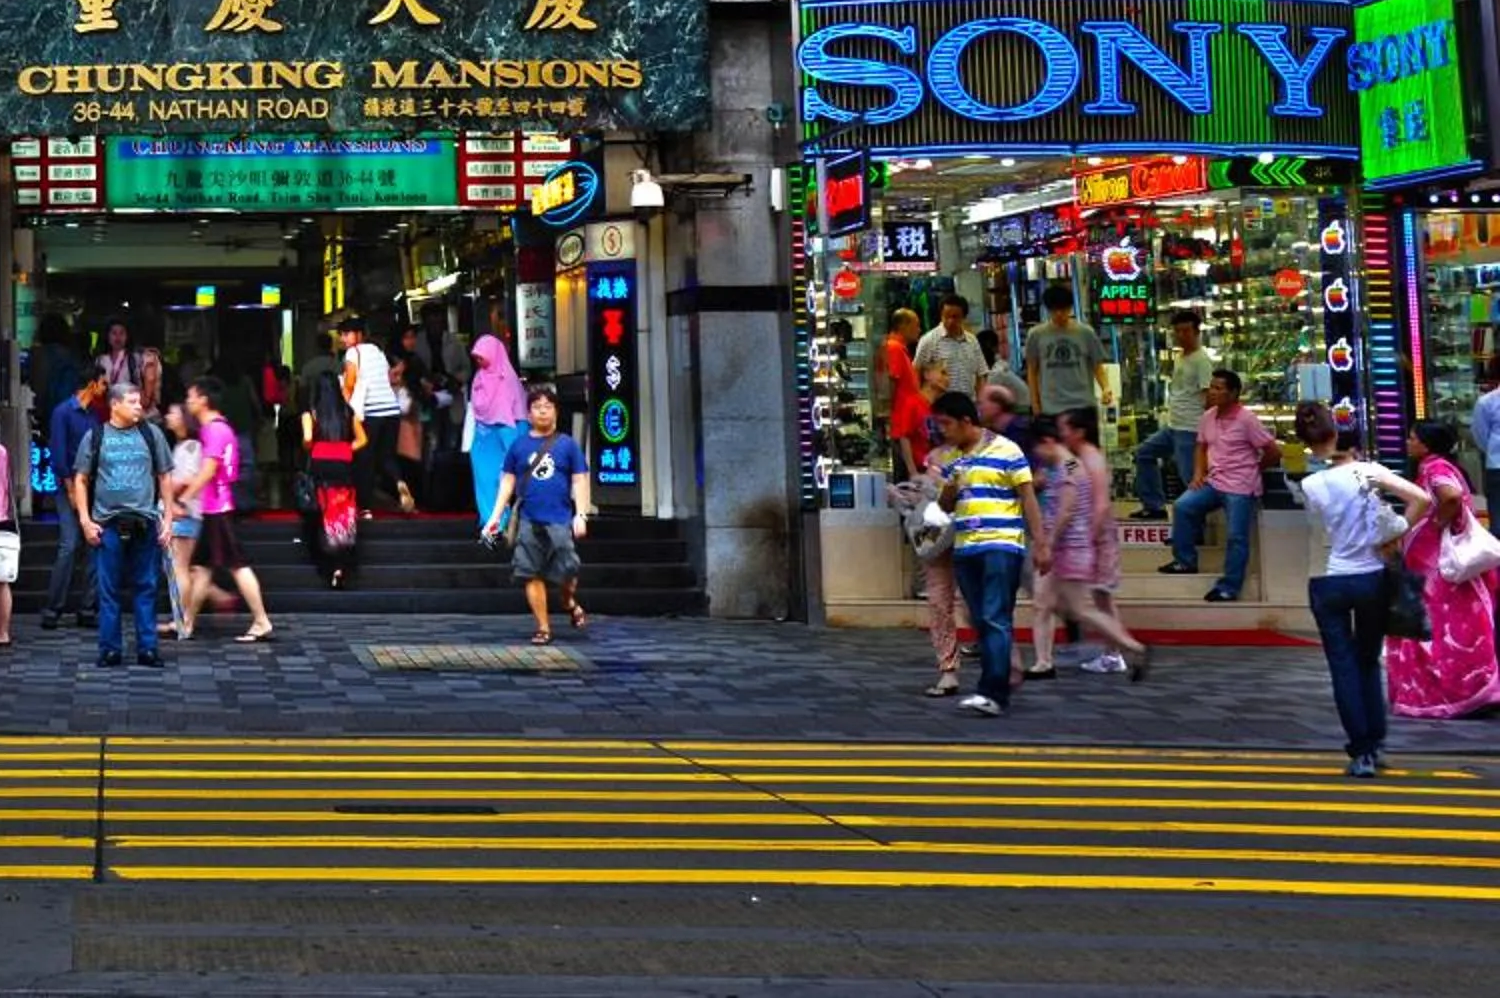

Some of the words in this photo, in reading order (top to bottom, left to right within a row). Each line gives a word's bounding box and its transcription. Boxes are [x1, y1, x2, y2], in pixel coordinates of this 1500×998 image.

[799, 17, 1348, 125] SONY
[1347, 18, 1454, 92] SONY
[17, 61, 343, 95] CHUNGKING
[371, 60, 643, 89] MANSIONS
[73, 102, 140, 123] 36-44,
[149, 100, 248, 120] NATHAN
[258, 98, 329, 119] ROAD
[1131, 156, 1200, 198] Canon
[1101, 285, 1147, 300] APPLE
[1123, 527, 1169, 543] FREE
